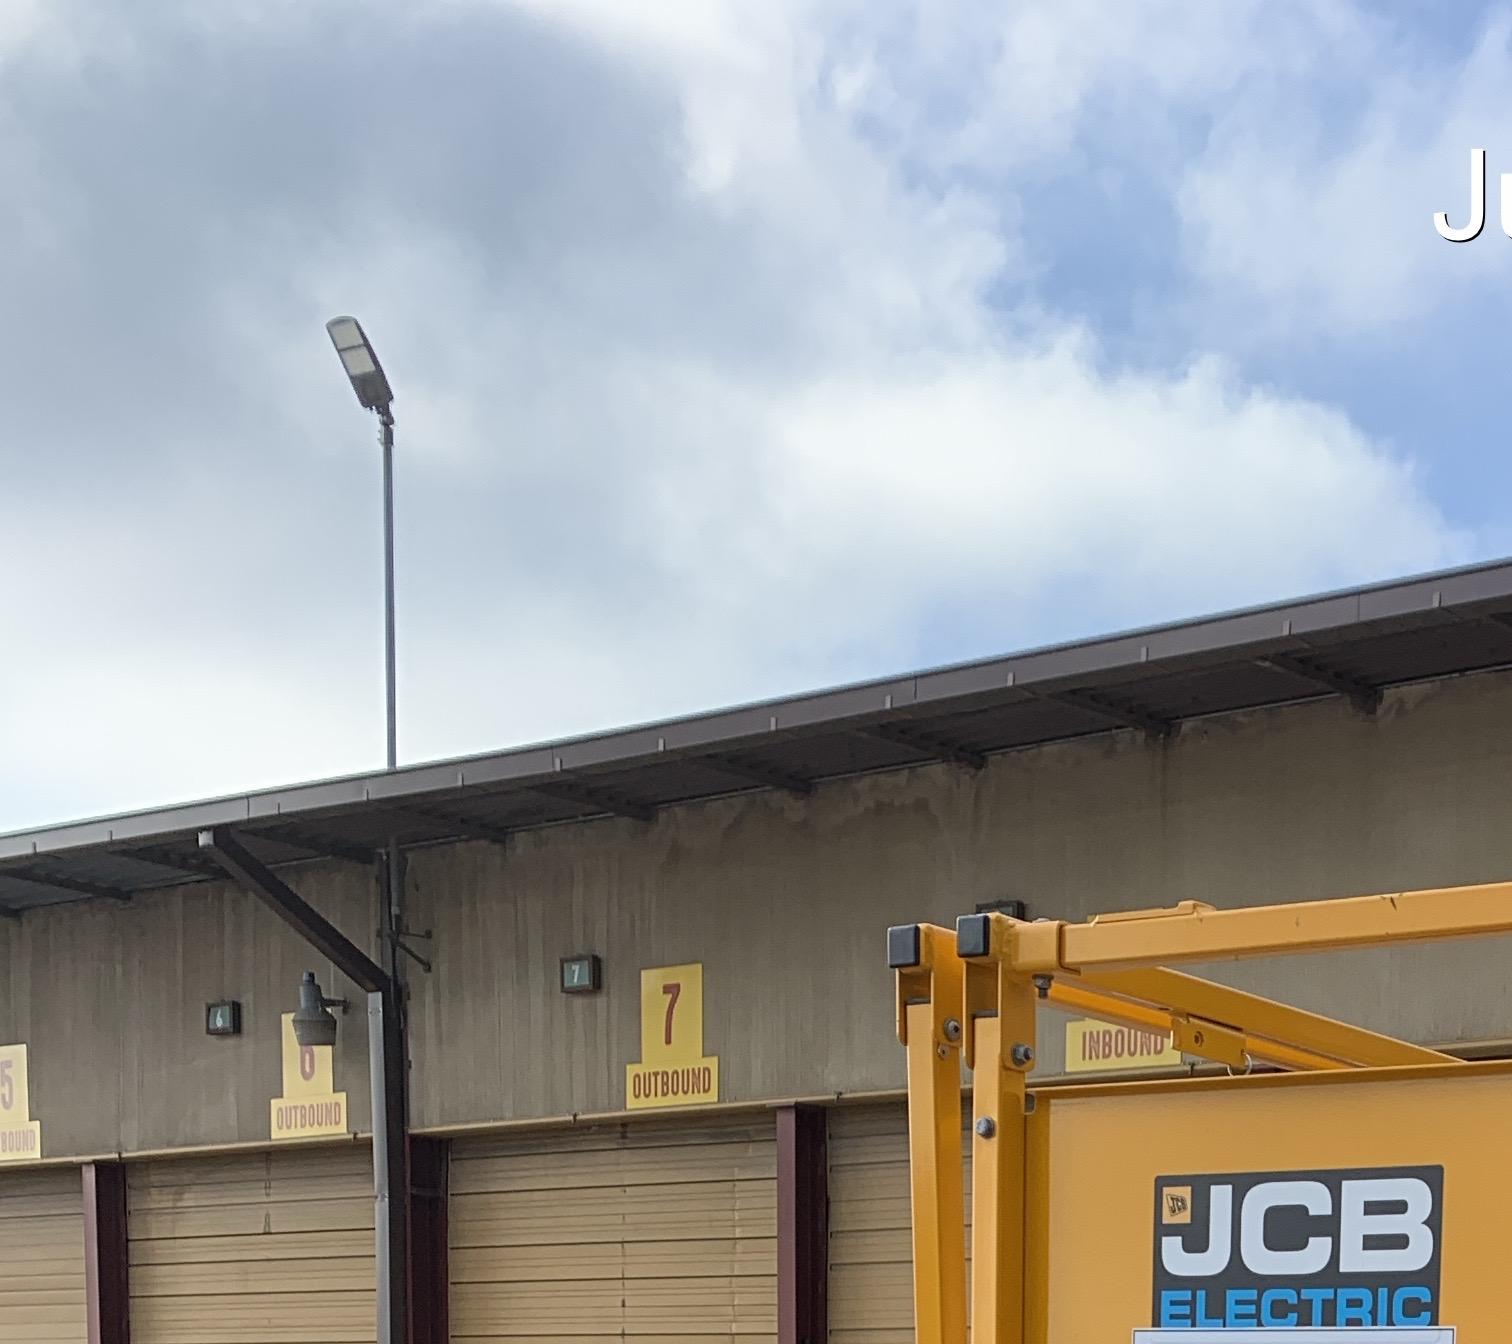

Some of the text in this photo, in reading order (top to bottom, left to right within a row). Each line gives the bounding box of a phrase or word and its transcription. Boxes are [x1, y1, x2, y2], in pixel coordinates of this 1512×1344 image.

[571, 964, 580, 983] 7
[662, 983, 680, 1045] 7
[1082, 1029, 1164, 1061] INBOUND
[0, 1060, 14, 1110] 5
[632, 1066, 711, 1099] OUTBOUND
[276, 1101, 341, 1130] OUTBOUND
[1161, 1177, 1434, 1276] JCB
[1160, 1286, 1432, 1328] ELECTRIC
